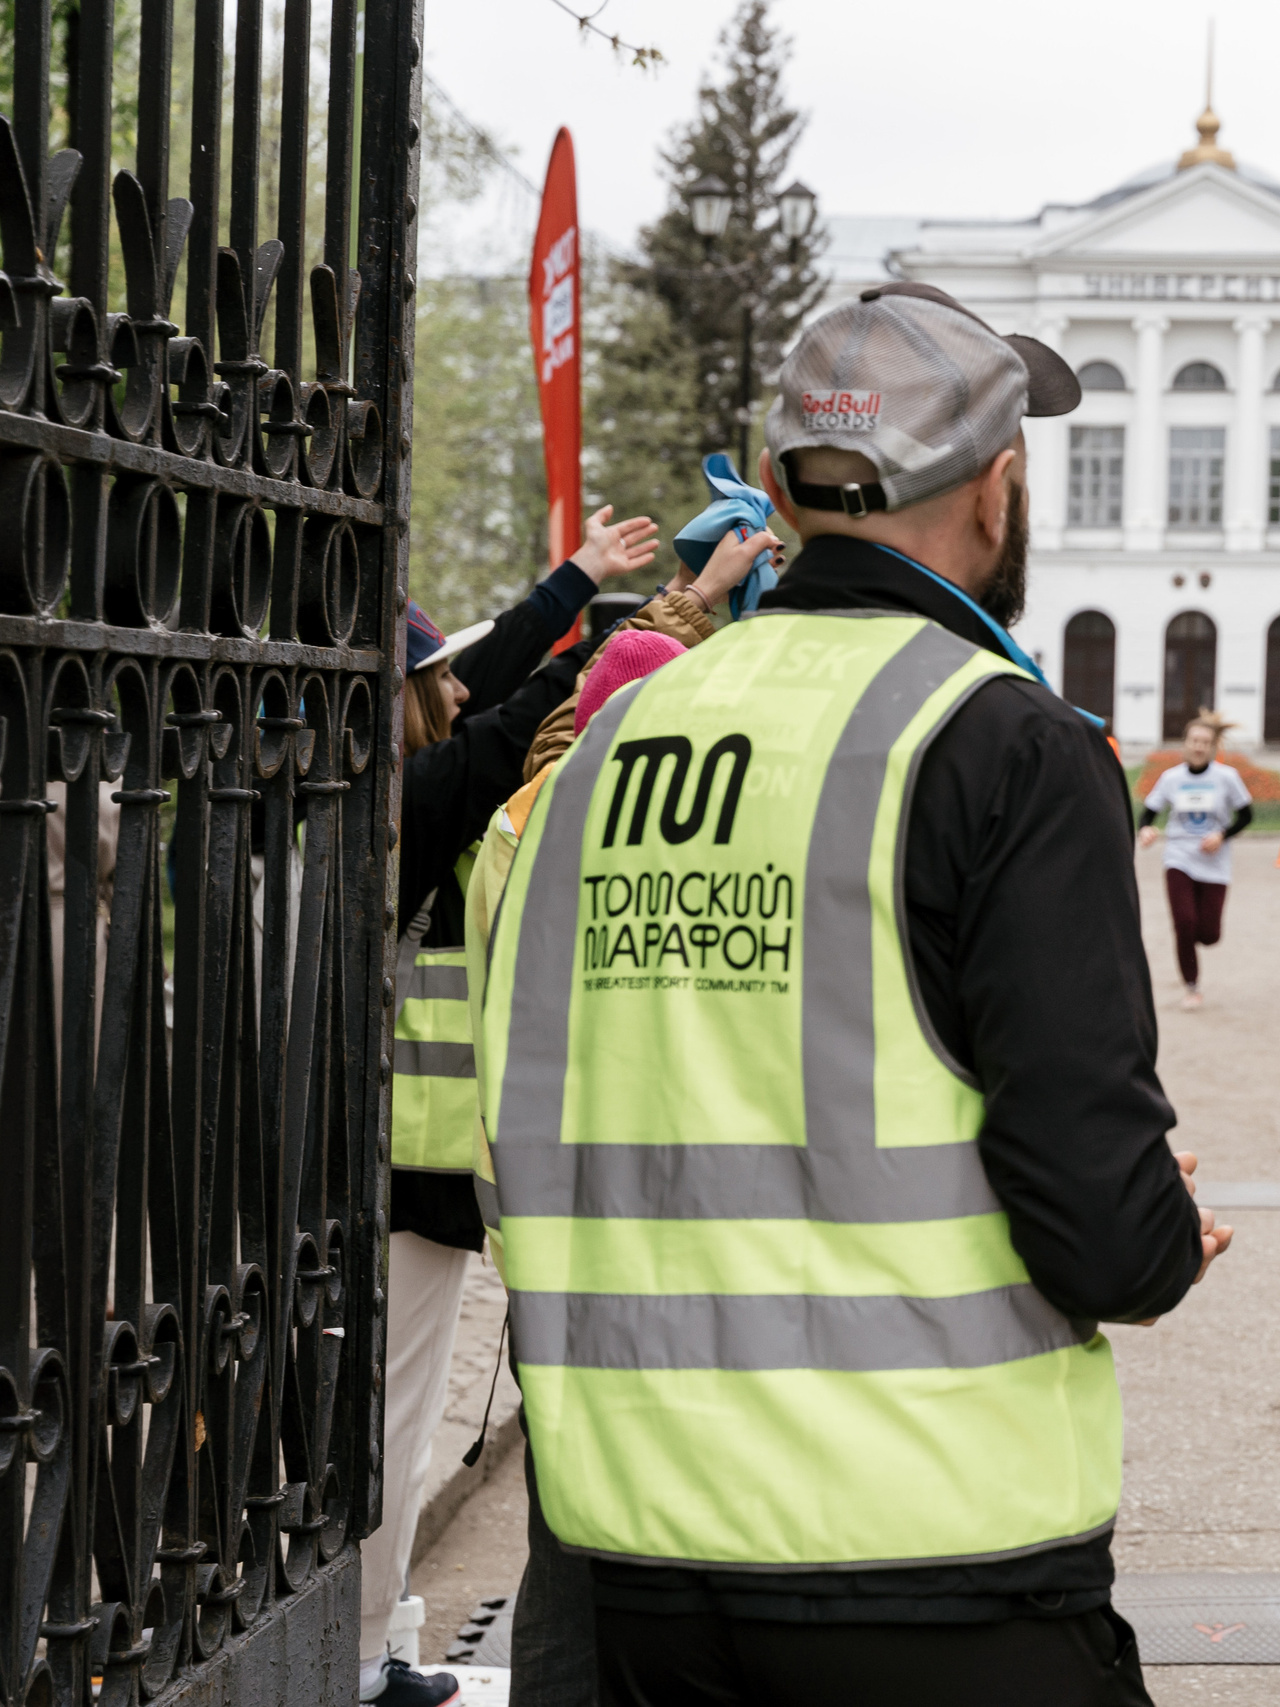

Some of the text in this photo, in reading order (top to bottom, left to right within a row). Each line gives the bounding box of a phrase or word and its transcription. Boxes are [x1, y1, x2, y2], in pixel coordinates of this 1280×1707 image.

[802, 393, 880, 414] Red Bull
[583, 863, 793, 921] ТОМСКИЙ
[583, 921, 792, 972] МАРАФОН
